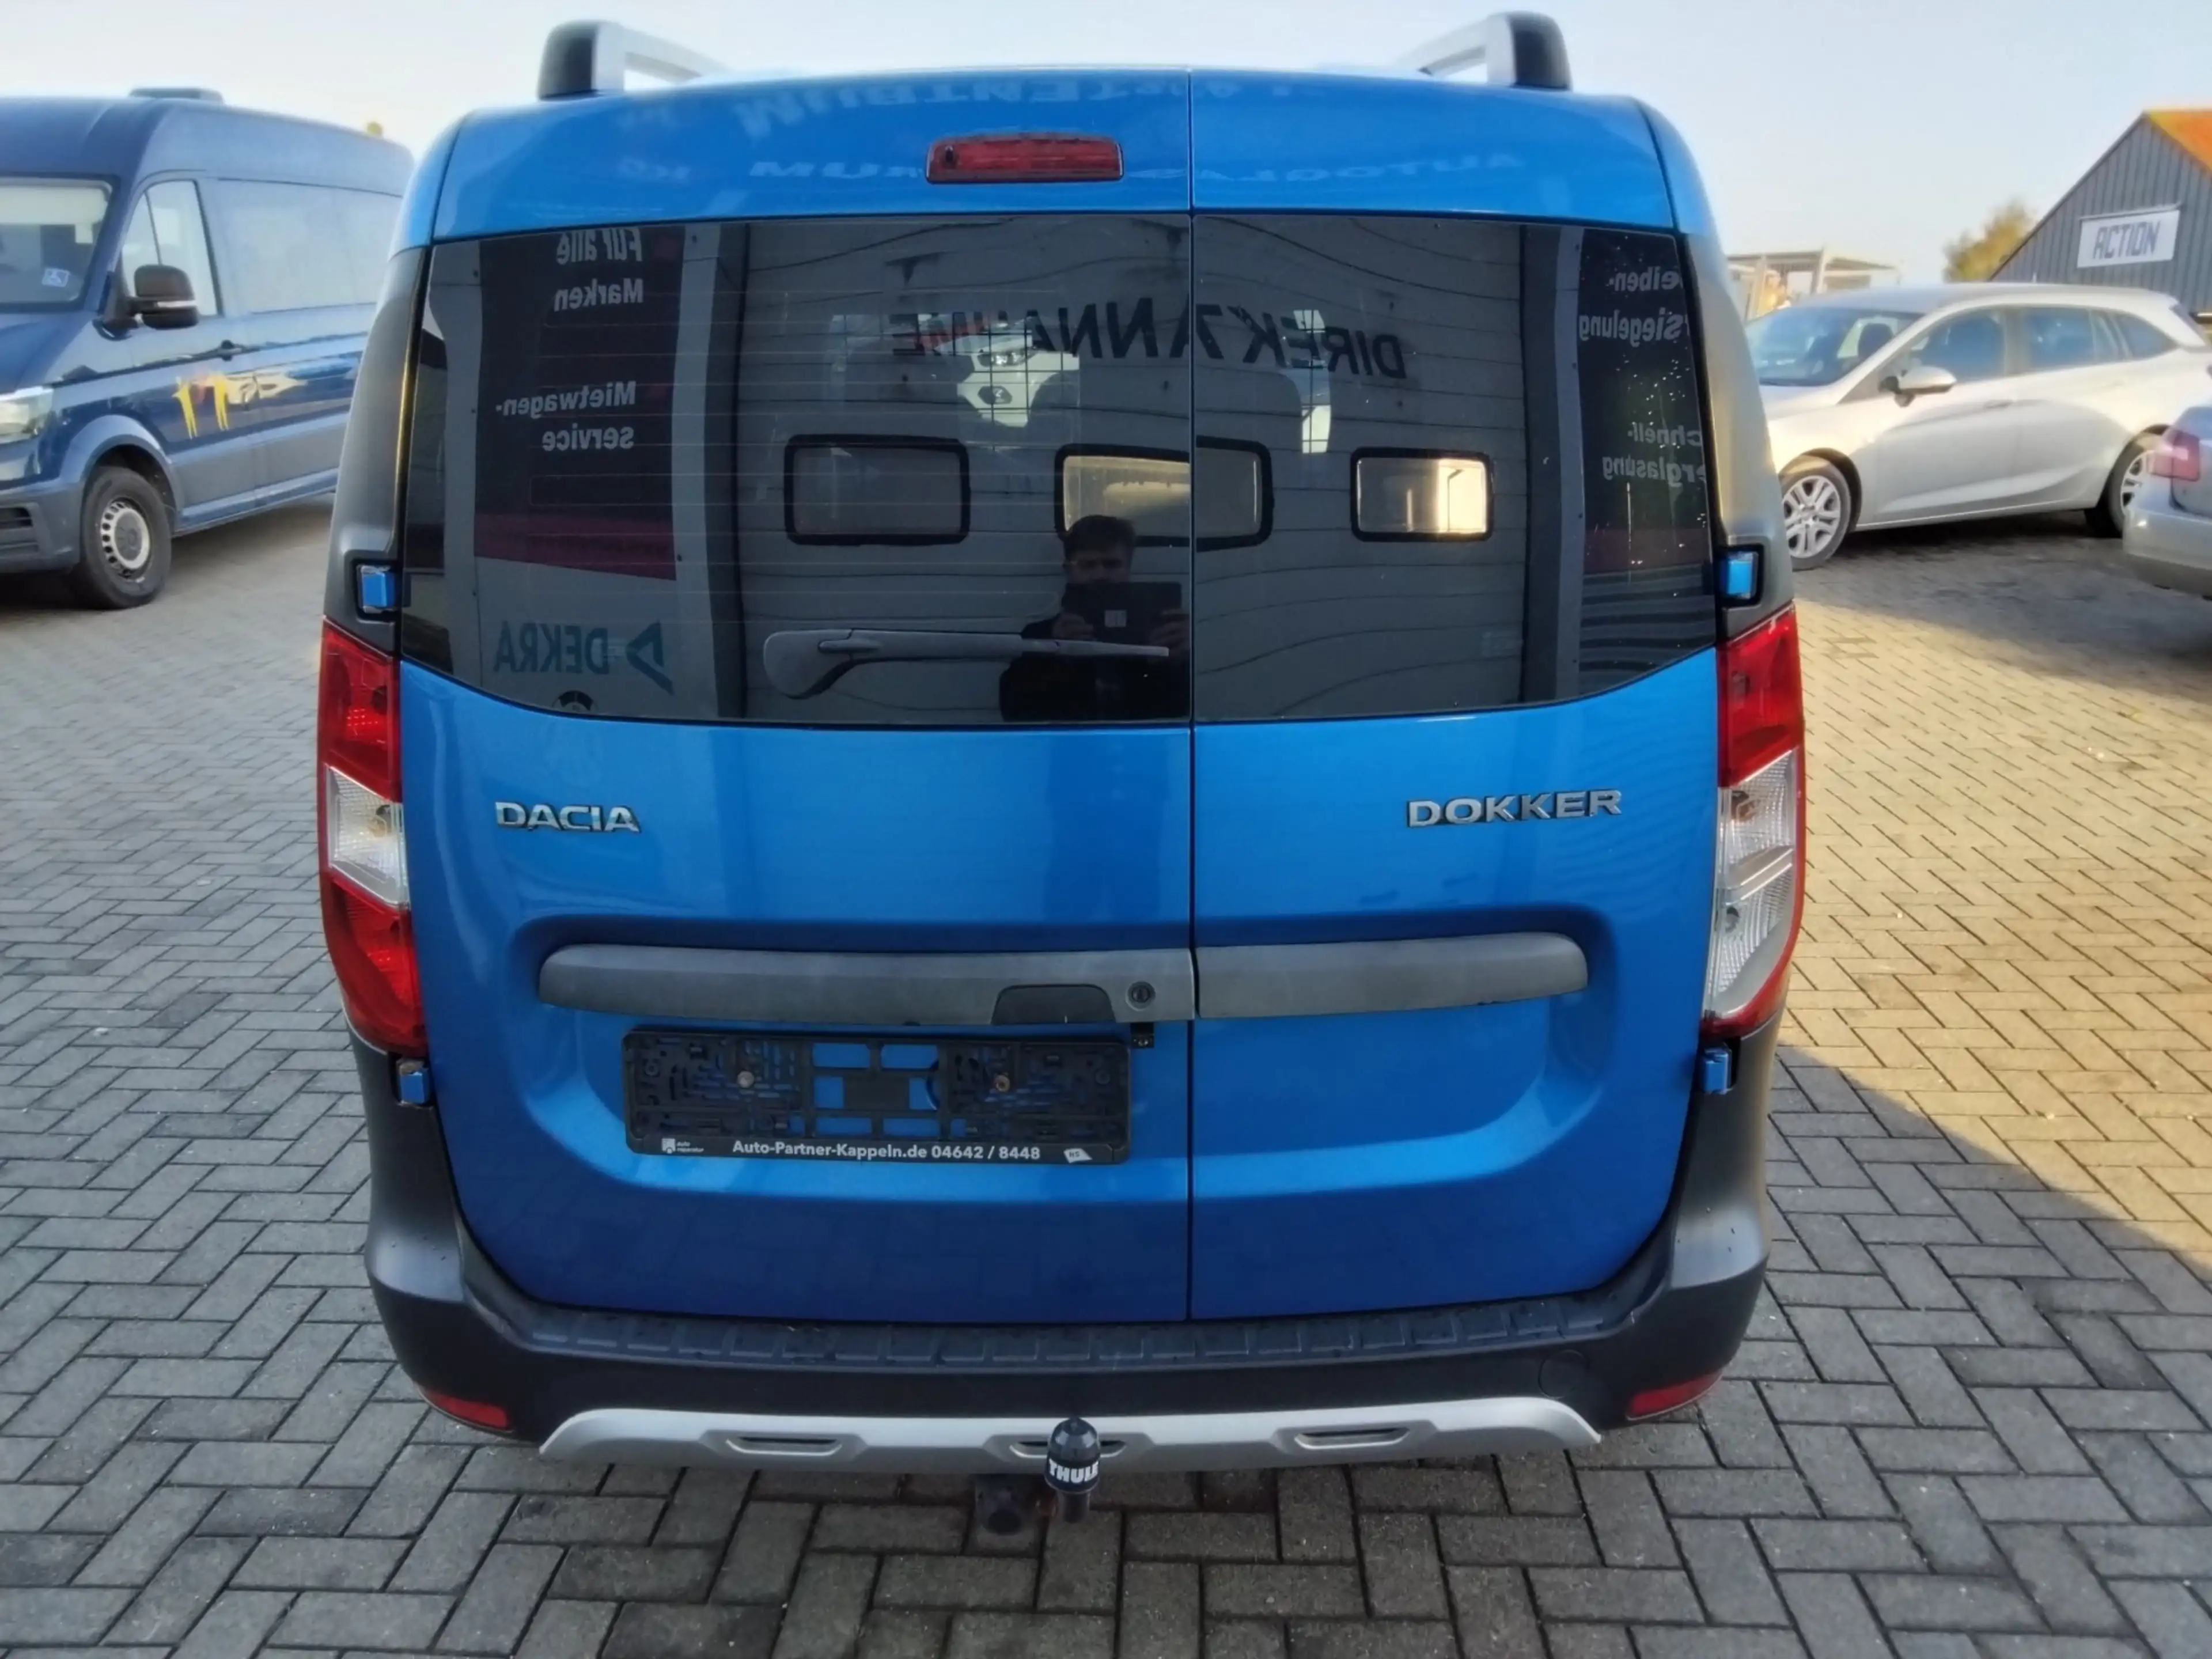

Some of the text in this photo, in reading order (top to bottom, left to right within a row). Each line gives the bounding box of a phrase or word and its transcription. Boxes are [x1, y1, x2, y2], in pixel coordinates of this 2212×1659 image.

[2092, 221, 2161, 260] ACTION
[495, 801, 641, 833] DACIA
[1407, 789, 1622, 828] DOKKER
[733, 1140, 927, 1160] Auto-Partner-Kappeln.de
[931, 1146, 983, 1160] 04642
[998, 1146, 1040, 1160] 8448
